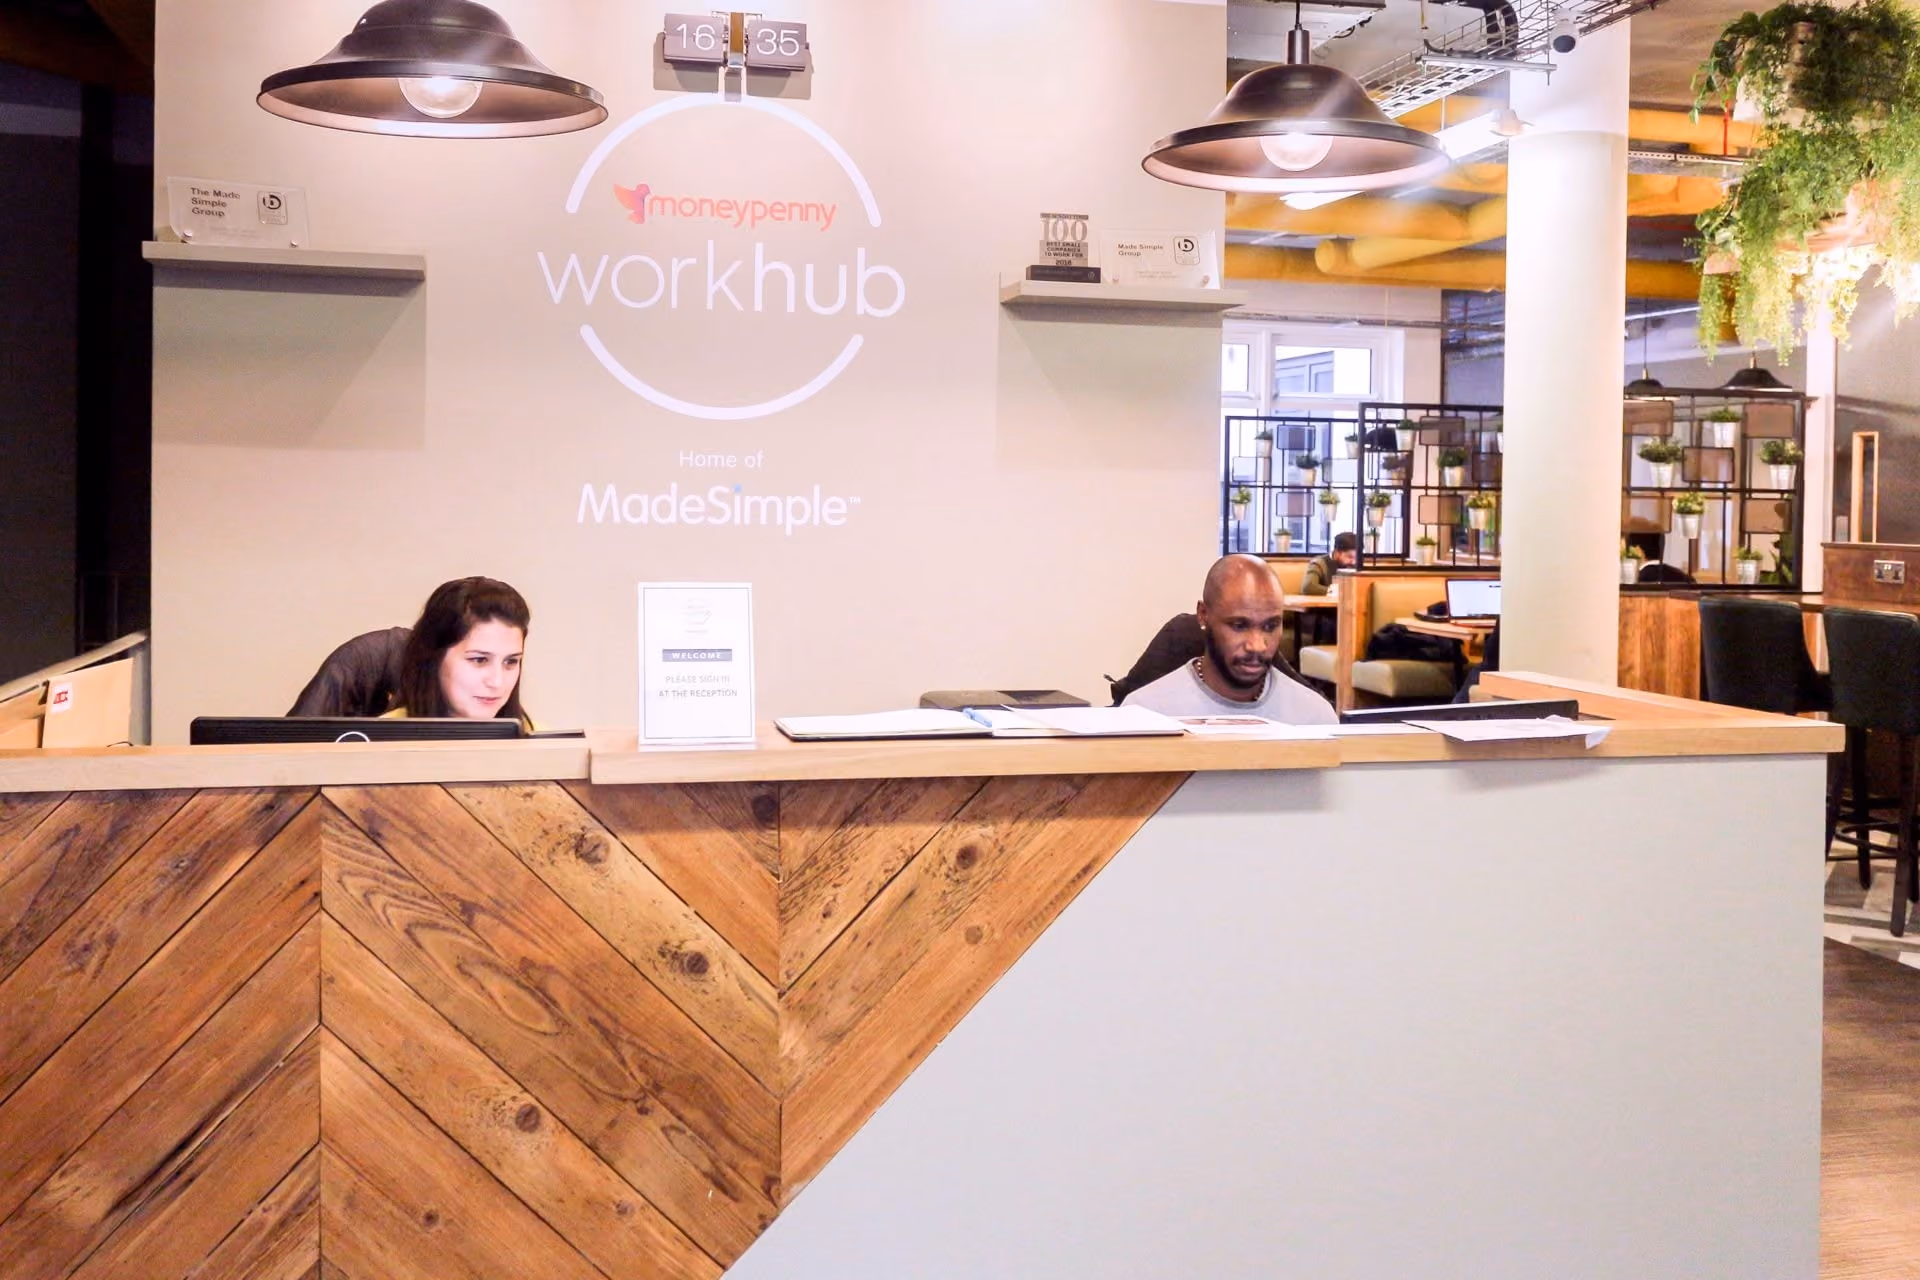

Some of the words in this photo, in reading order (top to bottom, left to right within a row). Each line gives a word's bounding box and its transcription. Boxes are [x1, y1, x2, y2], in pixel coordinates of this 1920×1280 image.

[676, 23, 716, 51] 16
[756, 28, 800, 56] 35
[190, 186, 210, 197] The
[212, 189, 241, 200] Made
[191, 197, 228, 209] Simple
[191, 207, 226, 218] Group
[649, 195, 838, 232] moneypenny
[1040, 218, 1088, 241] 100
[1139, 243, 1164, 251] Simple
[537, 239, 906, 318] workhub
[679, 450, 738, 469] Home
[744, 449, 765, 469] of
[671, 651, 722, 660] WELCOME
[665, 674, 698, 684] PLEASE
[699, 674, 719, 684] SIGN
[658, 689, 670, 698] AT
[671, 689, 688, 698] THE
[690, 688, 738, 698] RECEPTION
